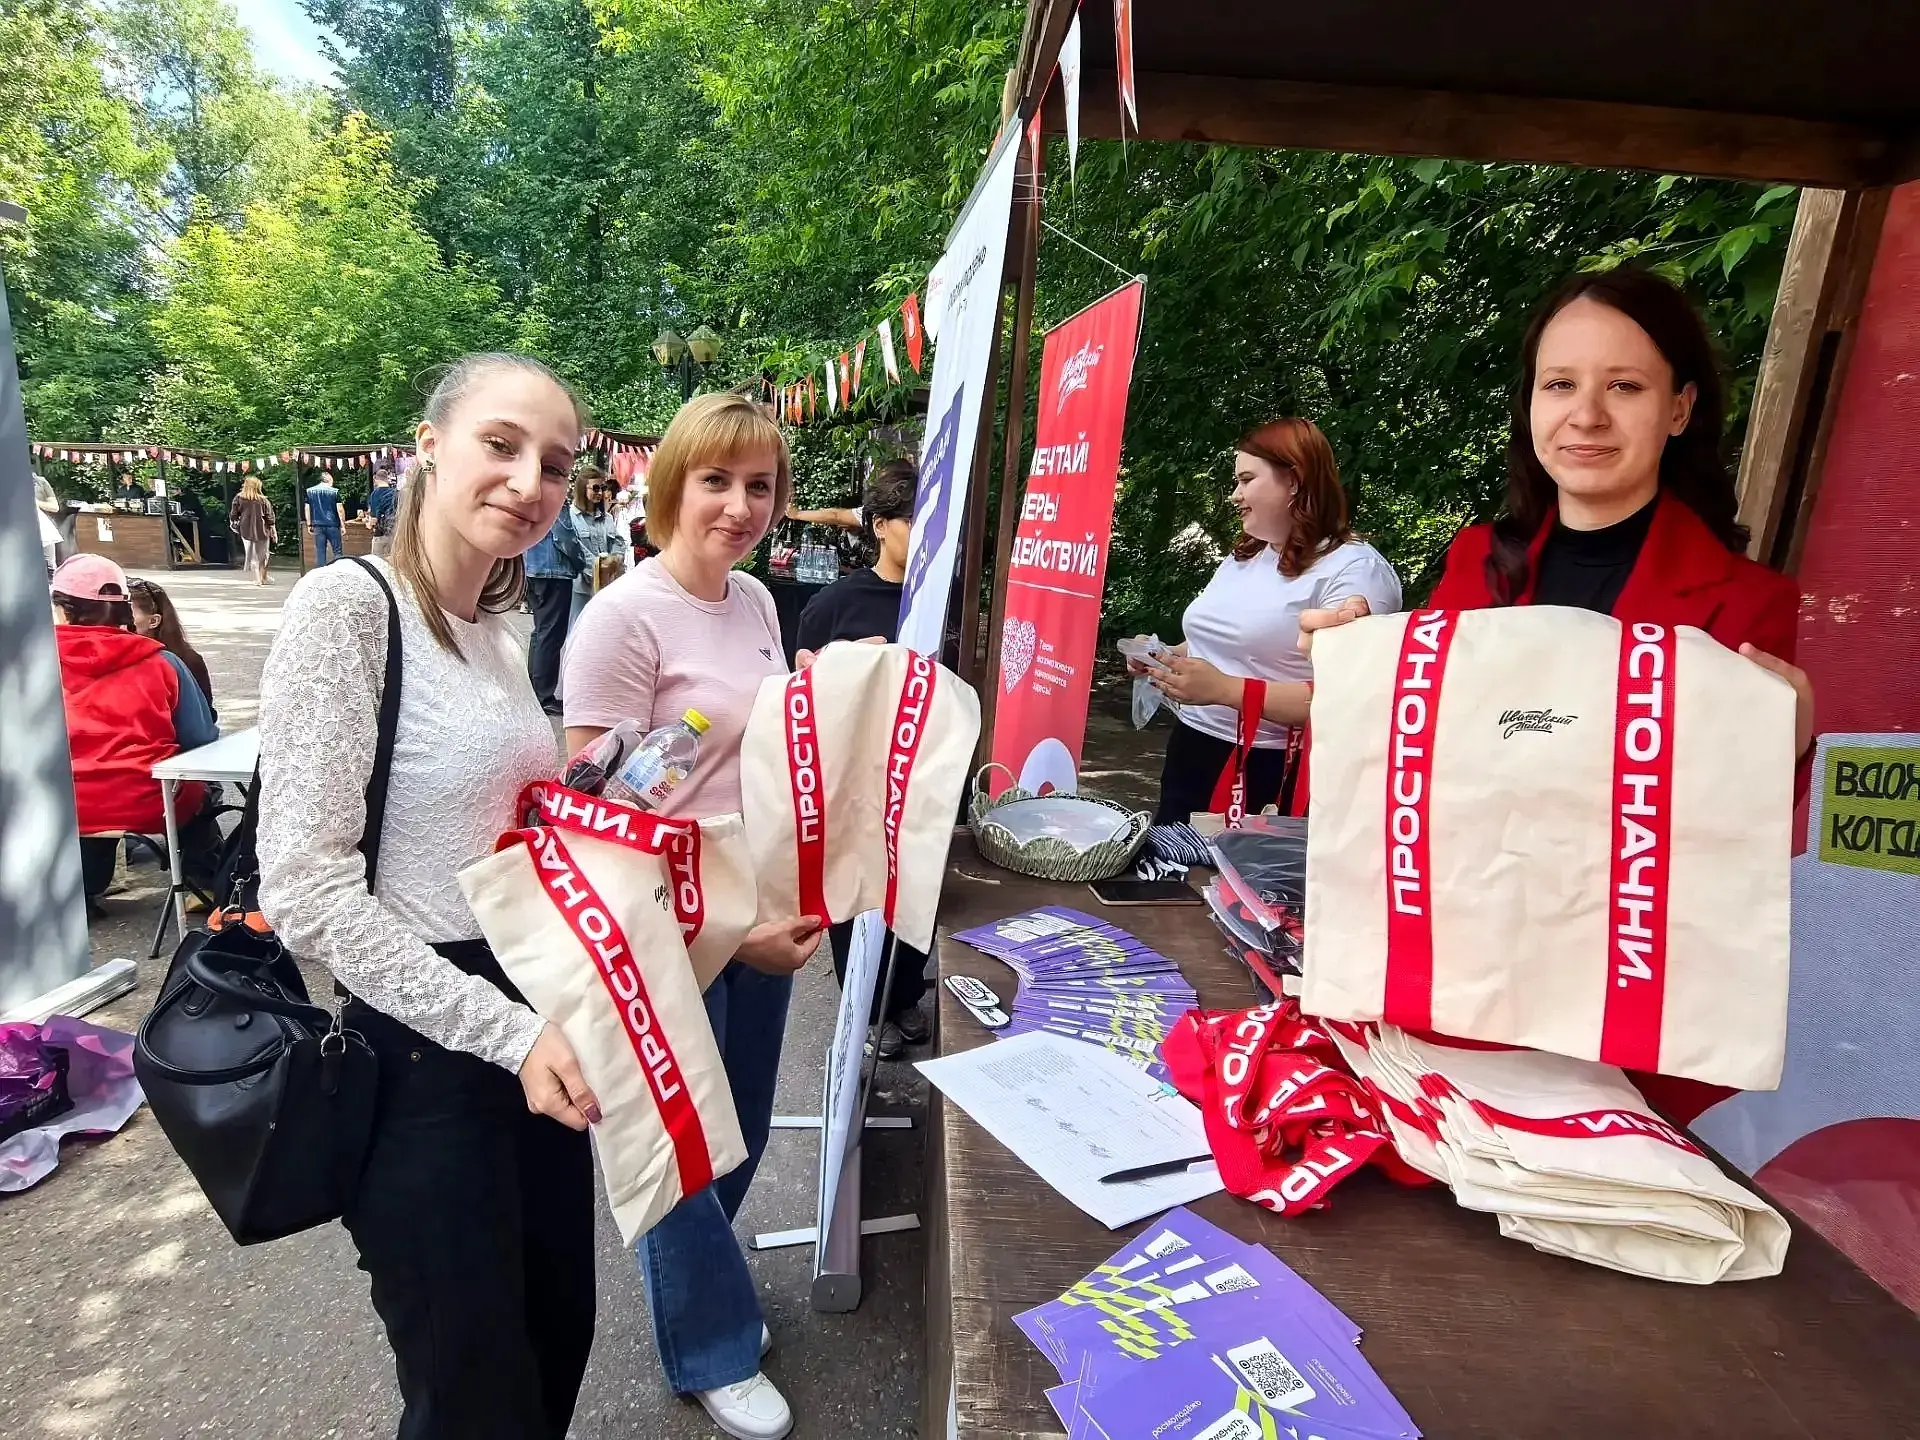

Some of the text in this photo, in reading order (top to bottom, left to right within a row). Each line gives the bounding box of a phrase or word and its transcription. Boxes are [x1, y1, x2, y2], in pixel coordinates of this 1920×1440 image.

[1010, 529, 1098, 577] ДЕЙСТВУЙ!
[790, 693, 819, 843] ПРОСТО
[1392, 694, 1427, 916] ПРОСТО
[1831, 813, 1920, 859] КОГД
[1617, 773, 1659, 989] НАЧНИ.
